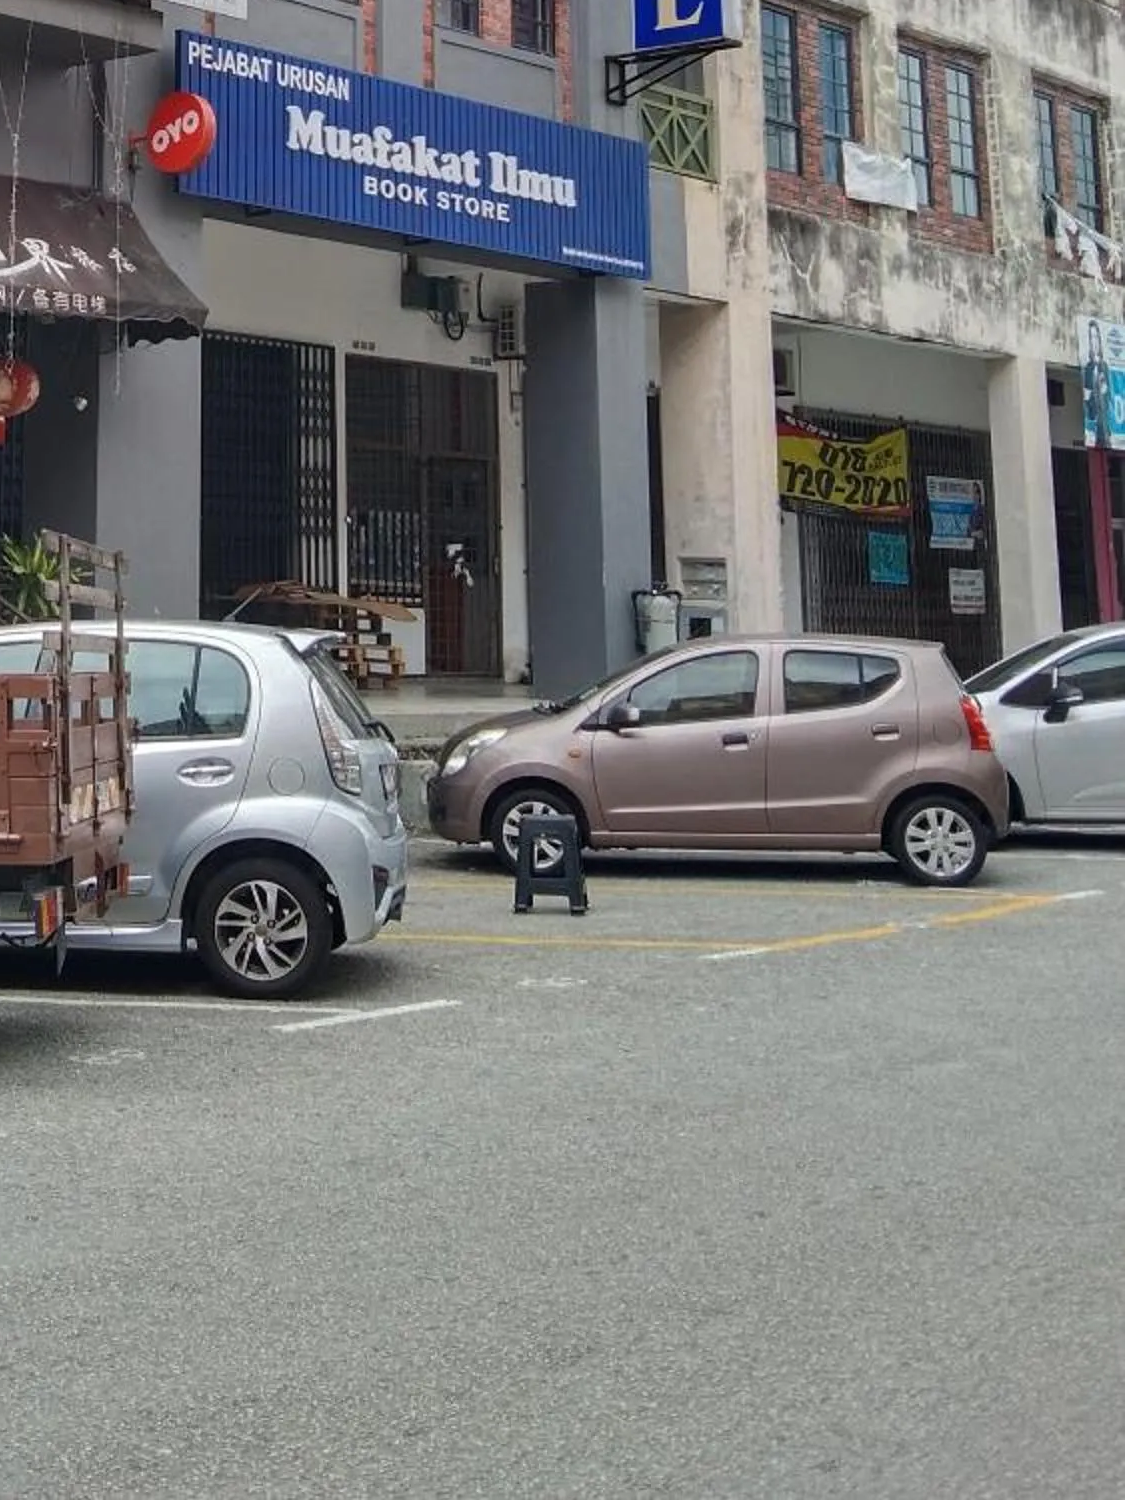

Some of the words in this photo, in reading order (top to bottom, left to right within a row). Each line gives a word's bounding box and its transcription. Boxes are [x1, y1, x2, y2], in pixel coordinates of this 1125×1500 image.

[187, 40, 272, 83] PEJABAT
[276, 62, 350, 101] URUSAN
[152, 109, 200, 153] OYO
[285, 105, 481, 188] Muafakat
[489, 151, 576, 207] Ilmu
[363, 175, 428, 206] BOOK
[436, 191, 510, 223] STORE
